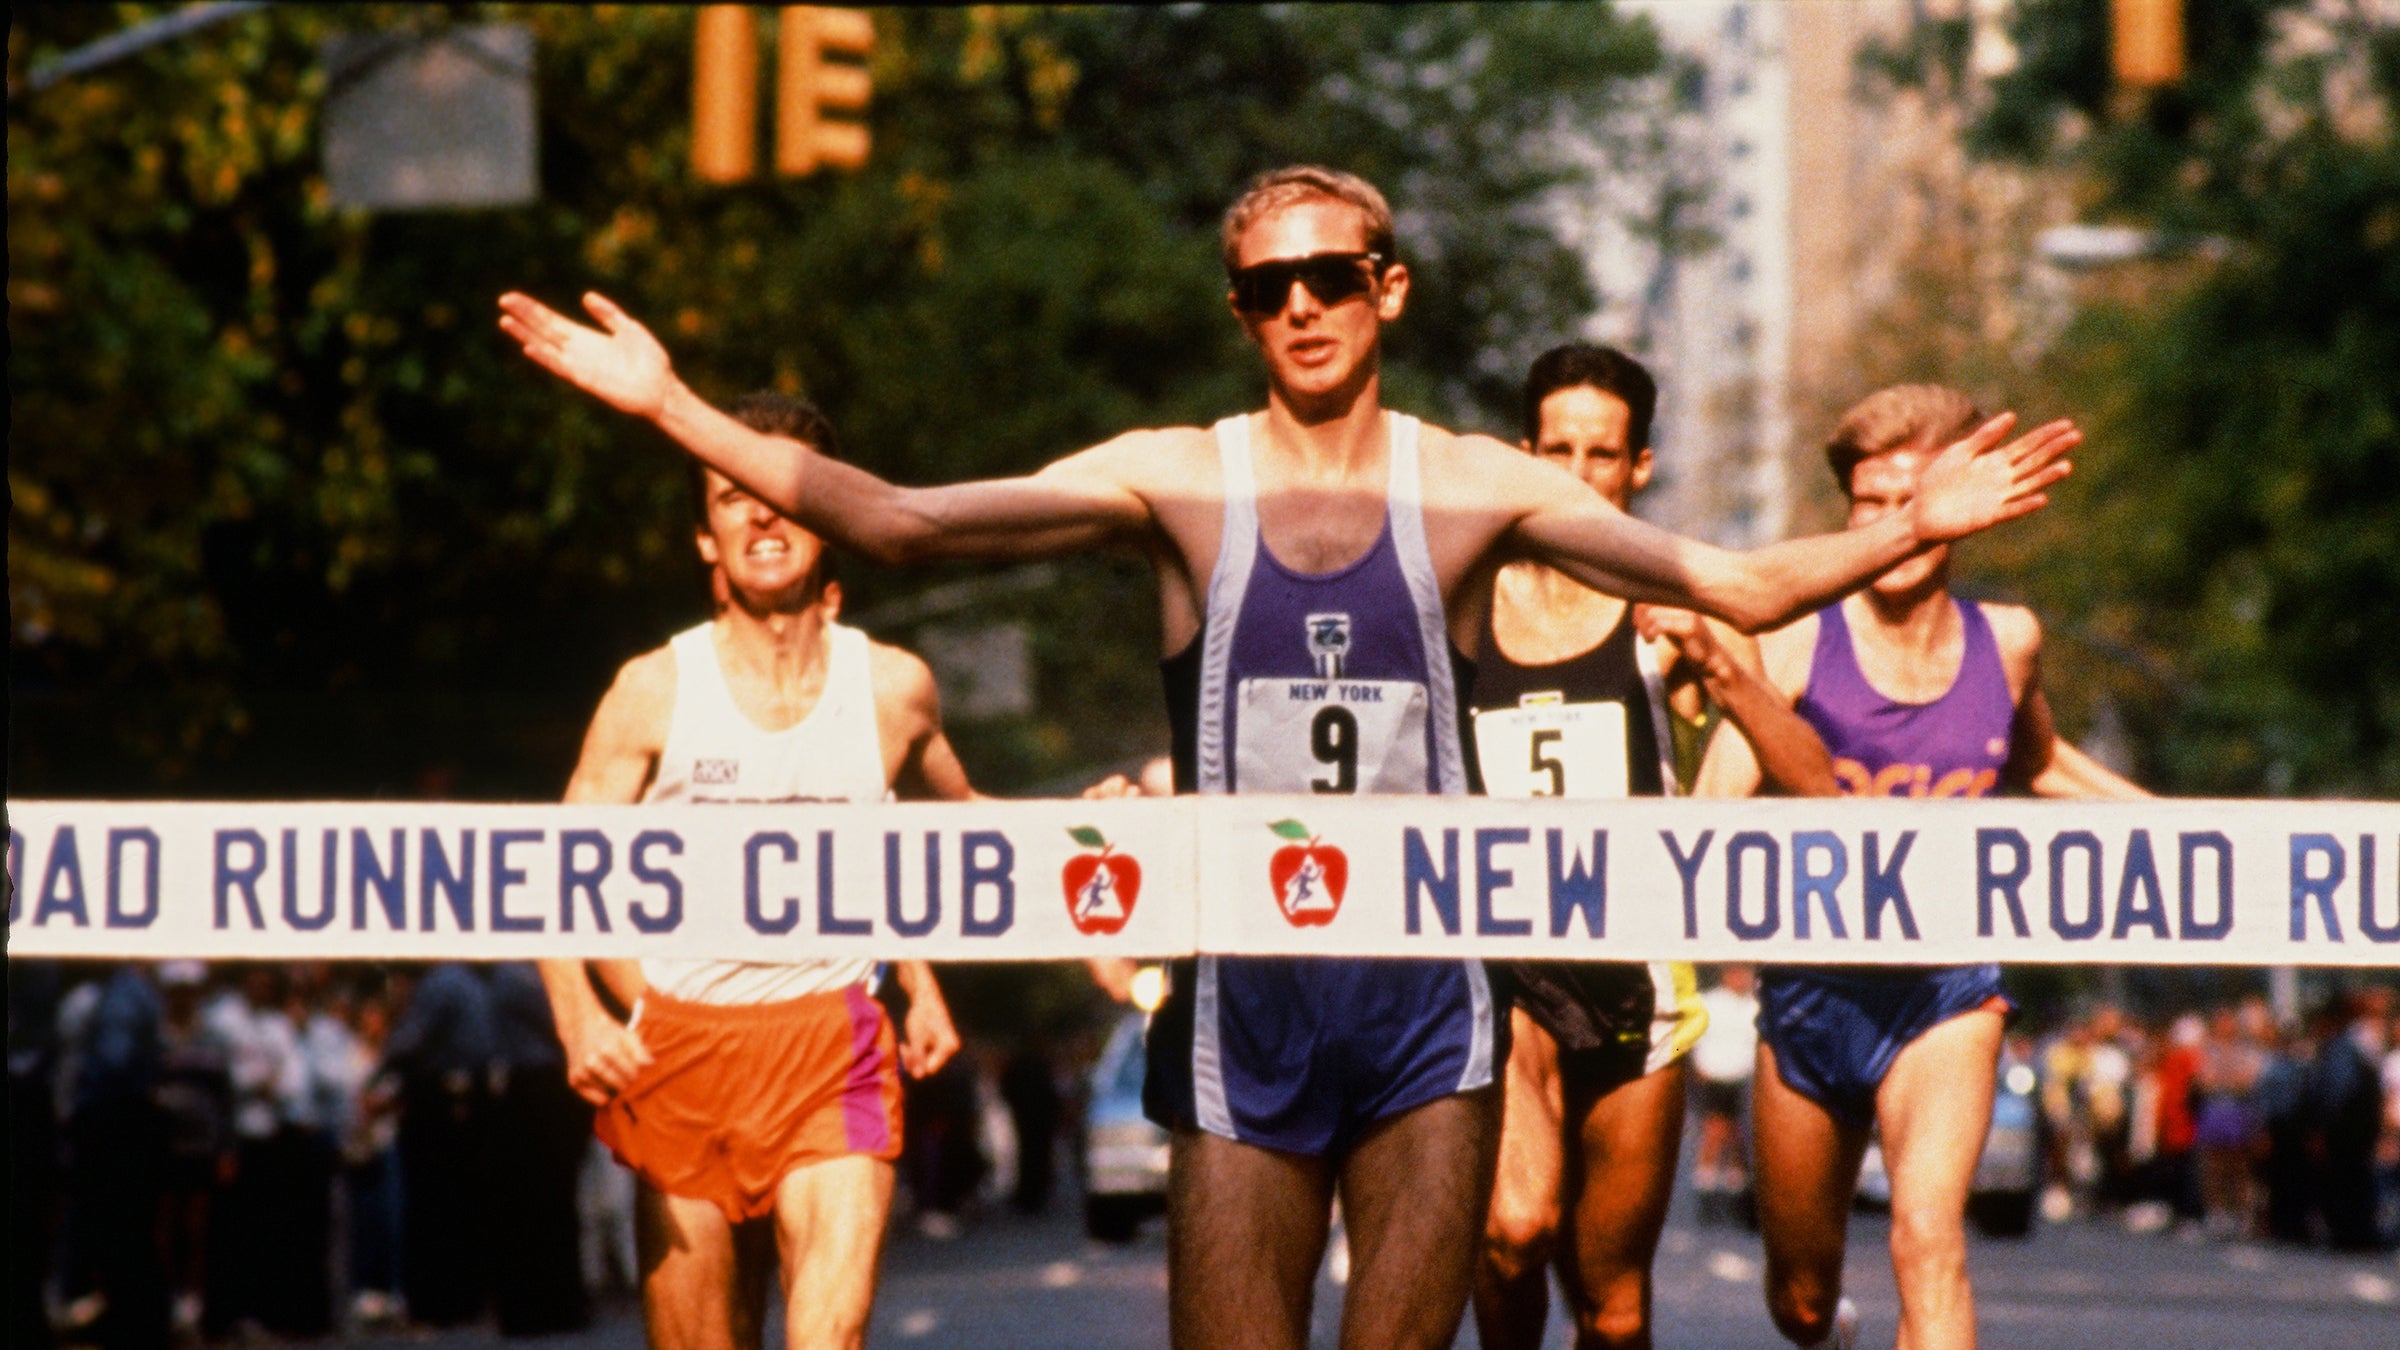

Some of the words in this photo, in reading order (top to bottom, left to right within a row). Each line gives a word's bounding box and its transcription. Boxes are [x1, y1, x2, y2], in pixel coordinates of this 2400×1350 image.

[1289, 684, 1328, 700] NEW
[1339, 685, 1383, 702] YORK
[1310, 704, 1358, 796] 9
[1530, 729, 1565, 798] 5
[9, 824, 161, 929] AD
[212, 826, 685, 934] RUNNERS
[742, 829, 1016, 938] CLUB
[1402, 826, 1609, 940] NEW
[1657, 828, 1921, 941] YORK
[1975, 827, 2235, 942] ROAD
[2288, 832, 2400, 943] RU
